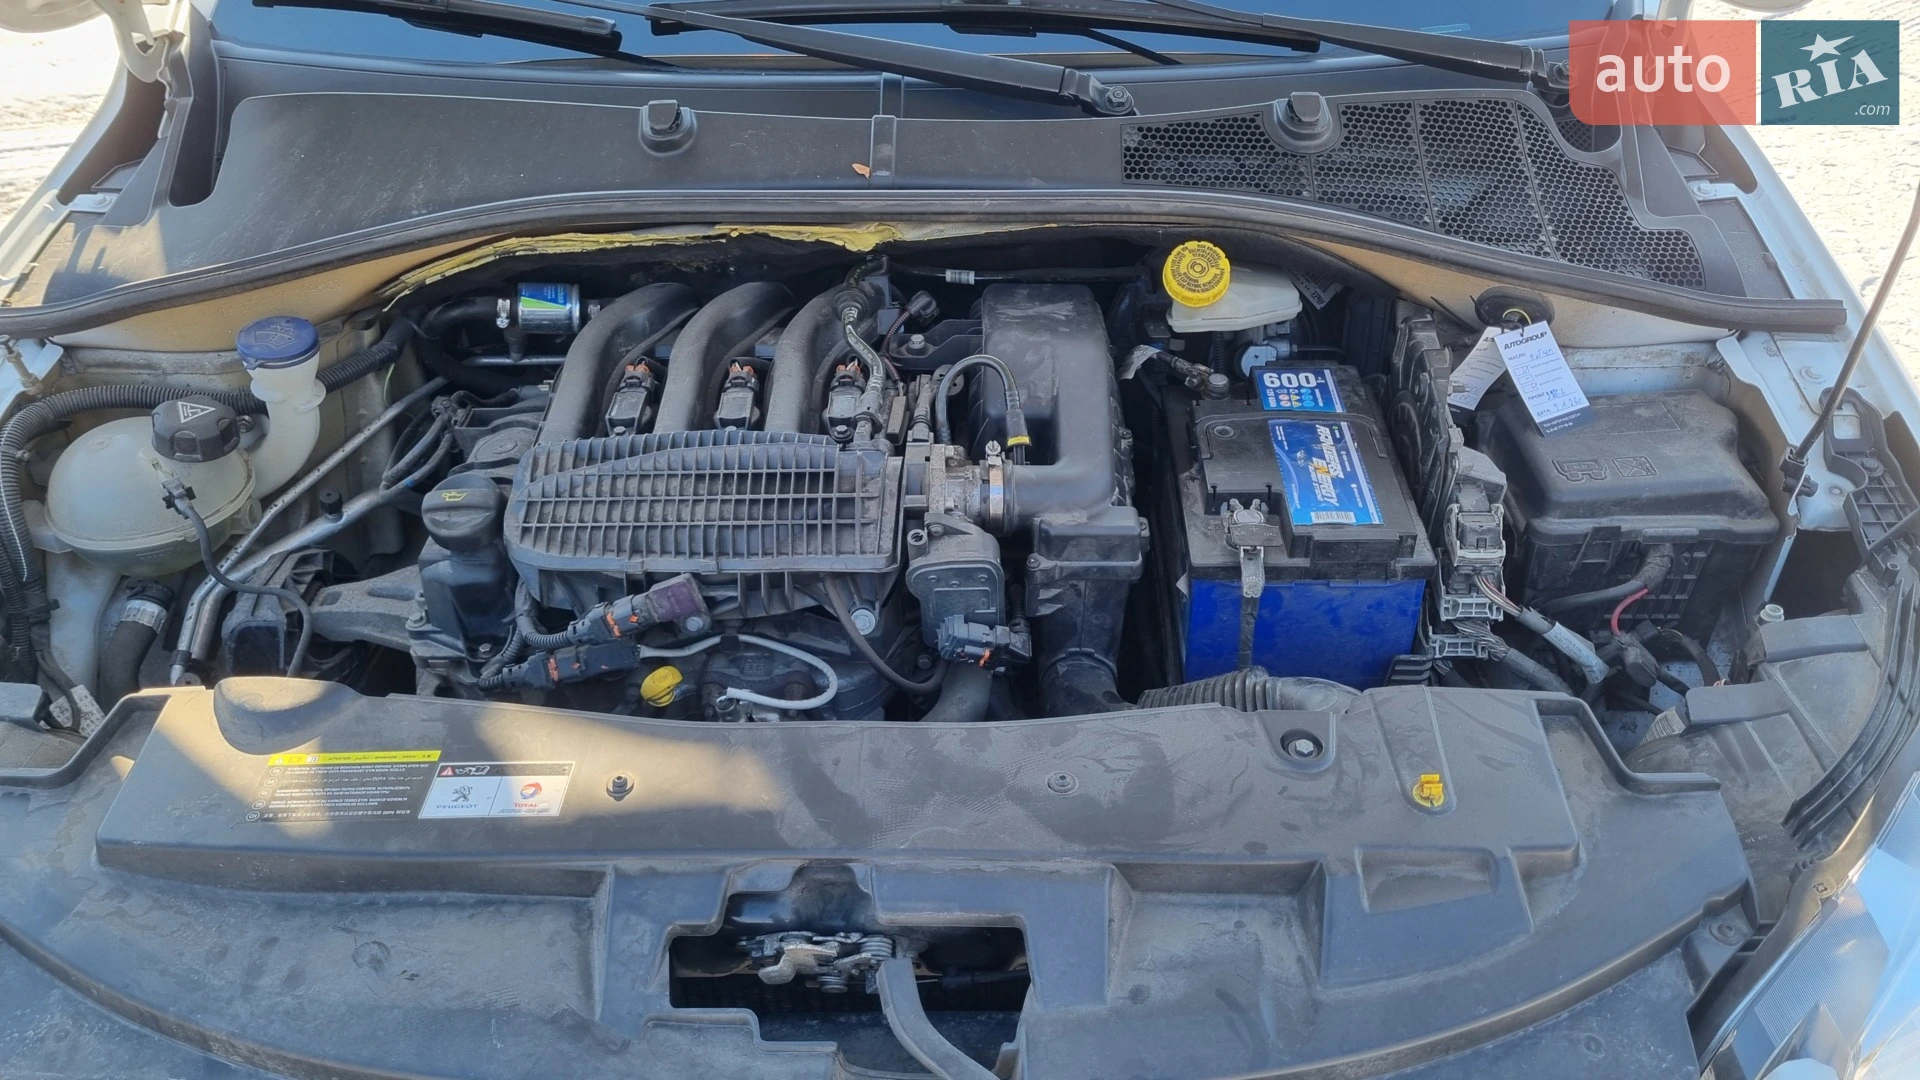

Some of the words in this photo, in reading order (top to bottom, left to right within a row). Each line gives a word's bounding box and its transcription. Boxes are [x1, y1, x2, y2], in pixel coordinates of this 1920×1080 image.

[1504, 331, 1548, 350] AUTOGROUP
[1508, 352, 1526, 361] МАСЛО
[1263, 372, 1318, 388] 600
[1316, 424, 1345, 479] RANGERS
[1311, 457, 1339, 507] ENERGY
